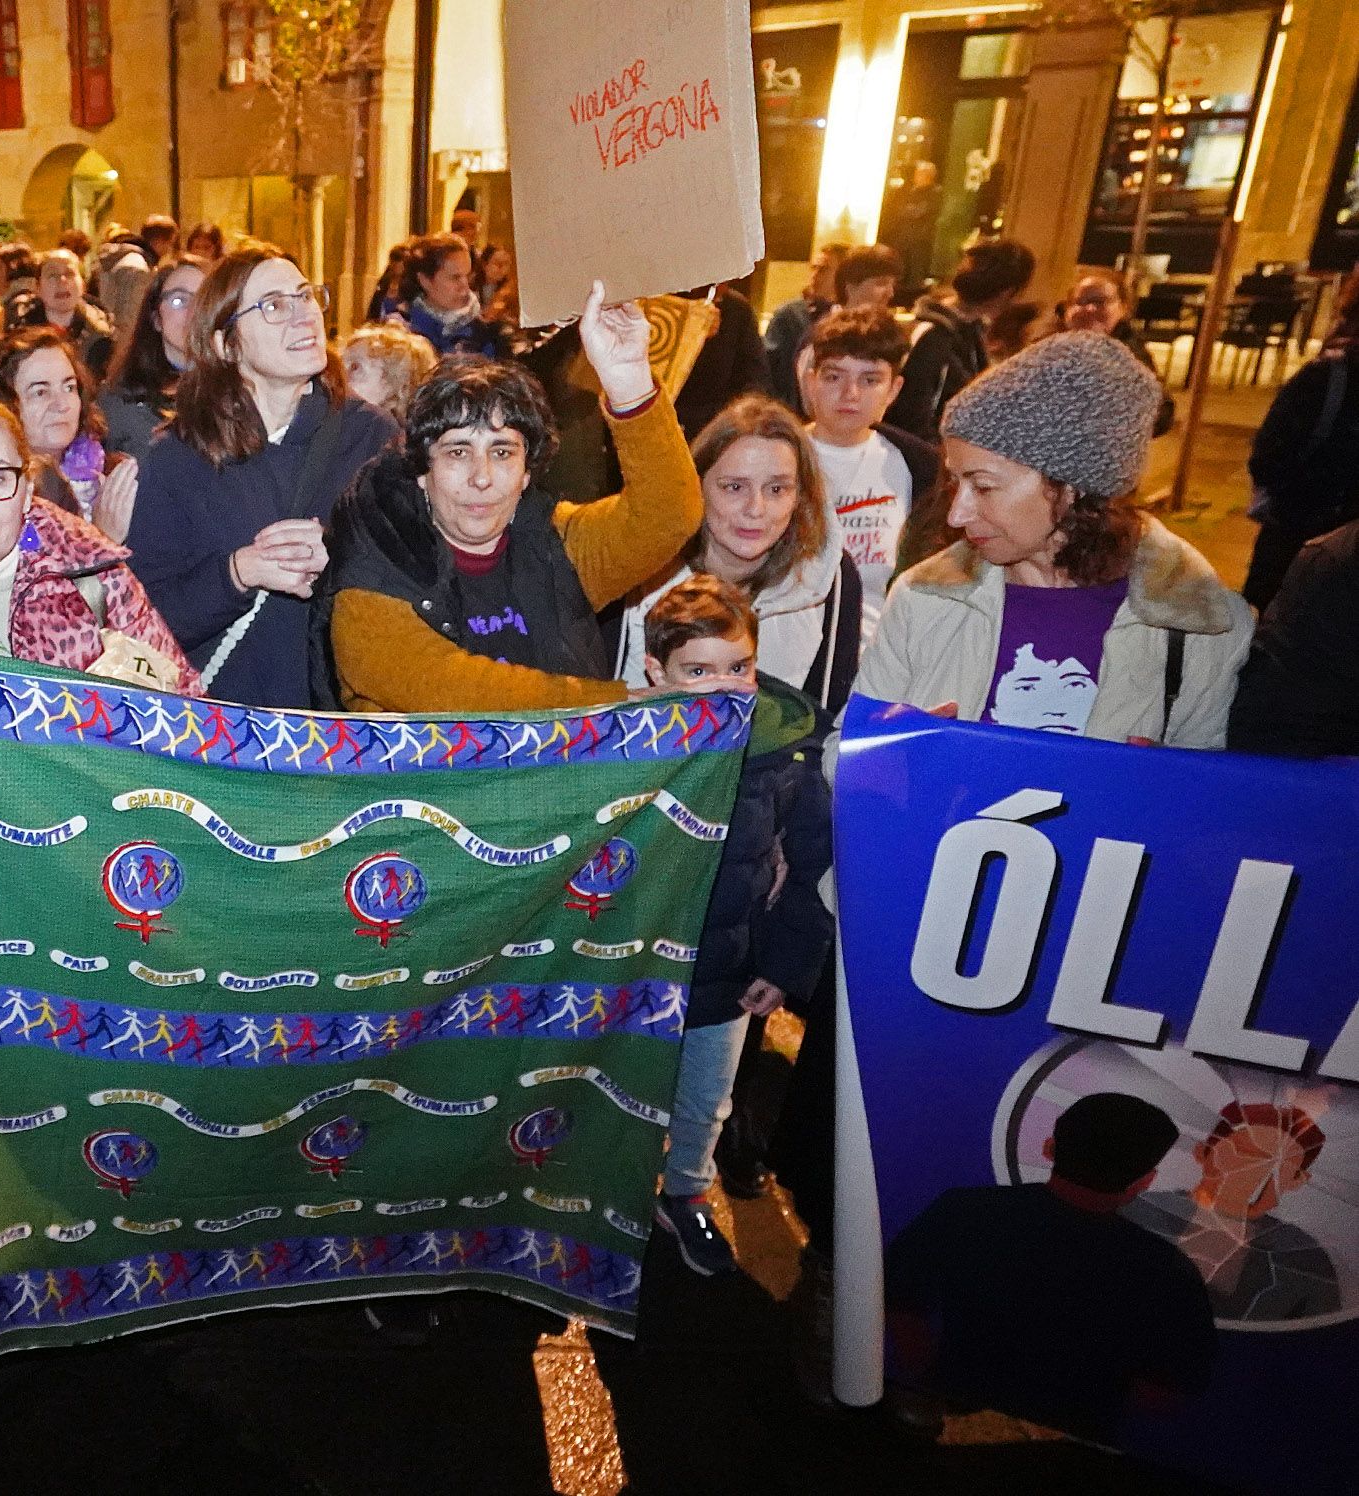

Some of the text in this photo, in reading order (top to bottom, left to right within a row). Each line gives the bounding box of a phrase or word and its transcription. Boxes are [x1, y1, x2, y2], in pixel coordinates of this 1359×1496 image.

[570, 59, 649, 125] VIOLADOR
[127, 792, 556, 864] CHARTE MONDIALE DES FEMMES POUR L'HUMANITE
[667, 803, 724, 840] MONDIALE
[62, 956, 97, 971] PAIX
[511, 942, 542, 956] PAIX
[224, 970, 316, 990] SOLIDARITE
[103, 1091, 166, 1105] CHARTE
[175, 1106, 240, 1136] MONDIALE
[403, 1092, 485, 1114] L'HUMANITE
[594, 1073, 659, 1120] MONDIALE
